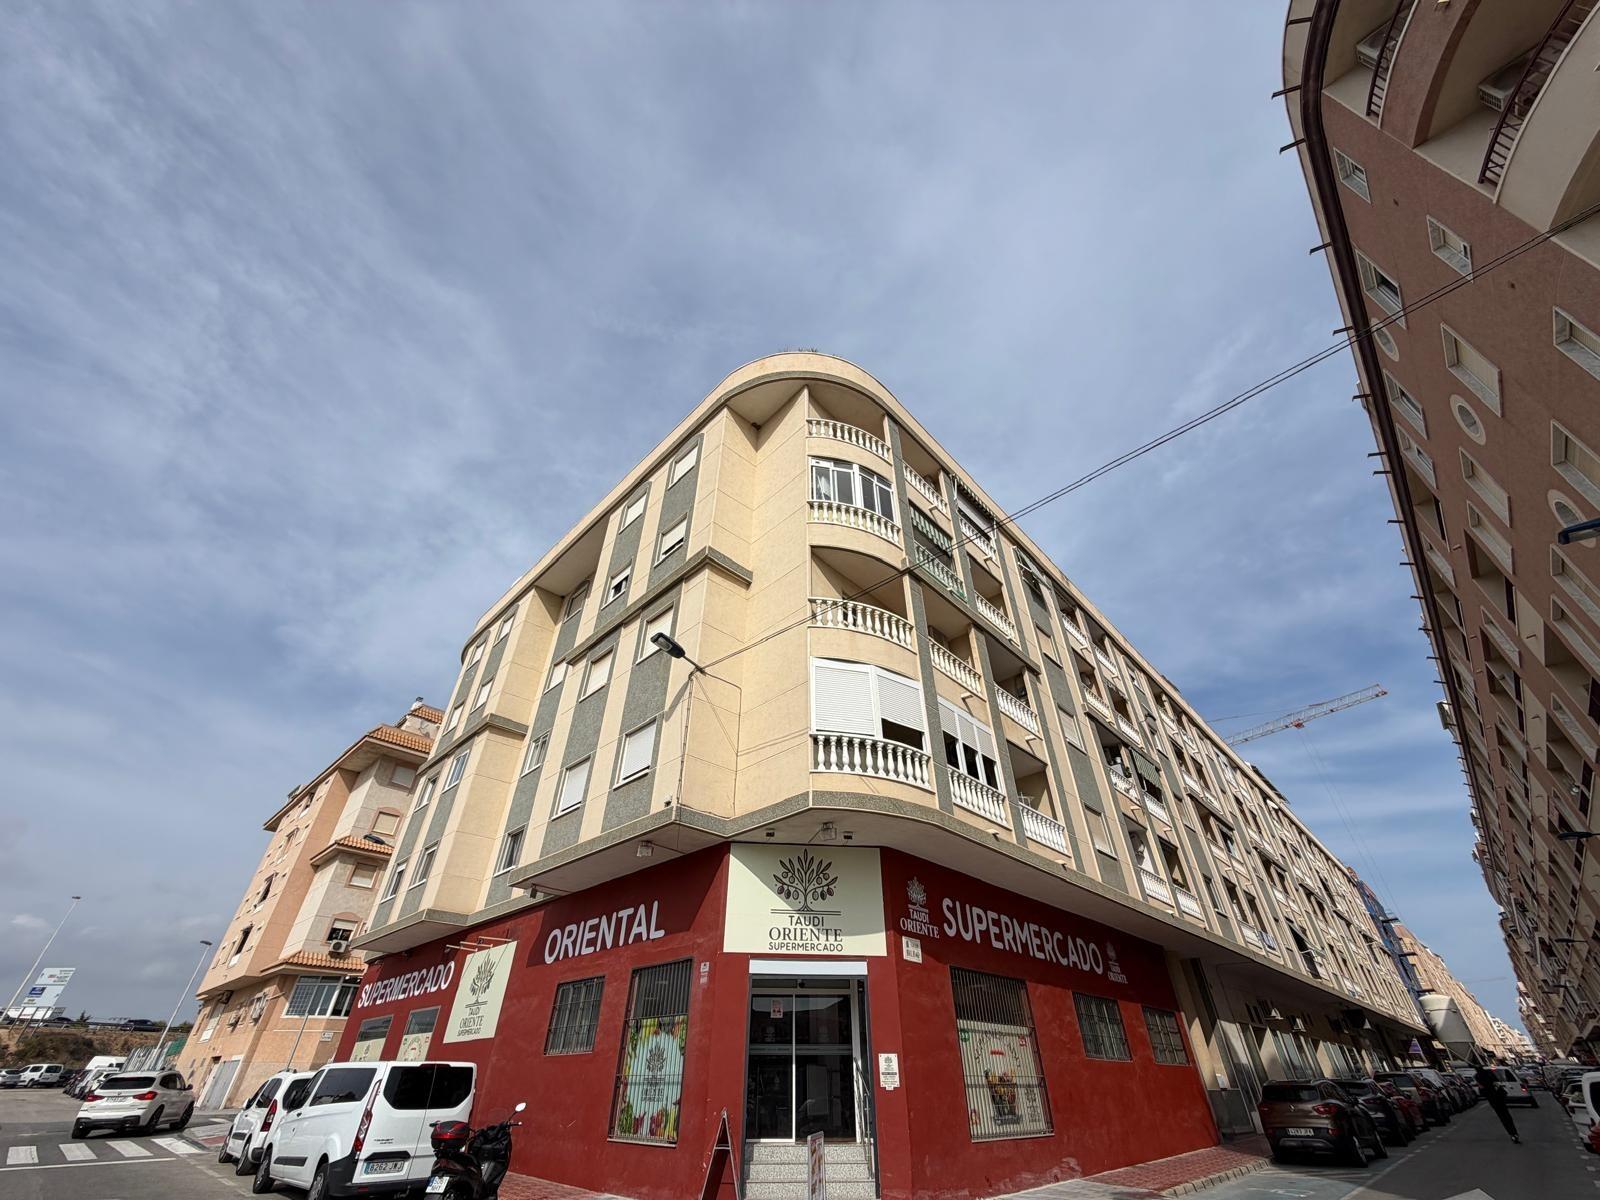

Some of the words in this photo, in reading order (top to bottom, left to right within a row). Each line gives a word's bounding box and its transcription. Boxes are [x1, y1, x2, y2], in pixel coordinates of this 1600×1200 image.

[788, 915, 825, 927] TAUDI
[909, 909, 930, 924] TAUDI
[544, 900, 665, 965] ORIENTAL
[769, 927, 843, 942] ORIENTE
[900, 917, 940, 939] ORIENTE
[942, 897, 1104, 975] SUPERMERCADO
[768, 941, 844, 952] SUPERMERCADO
[357, 960, 455, 1009] SUPERMERCADO
[468, 1006, 482, 1017] TAUDI
[459, 1015, 484, 1029] ORIENTE
